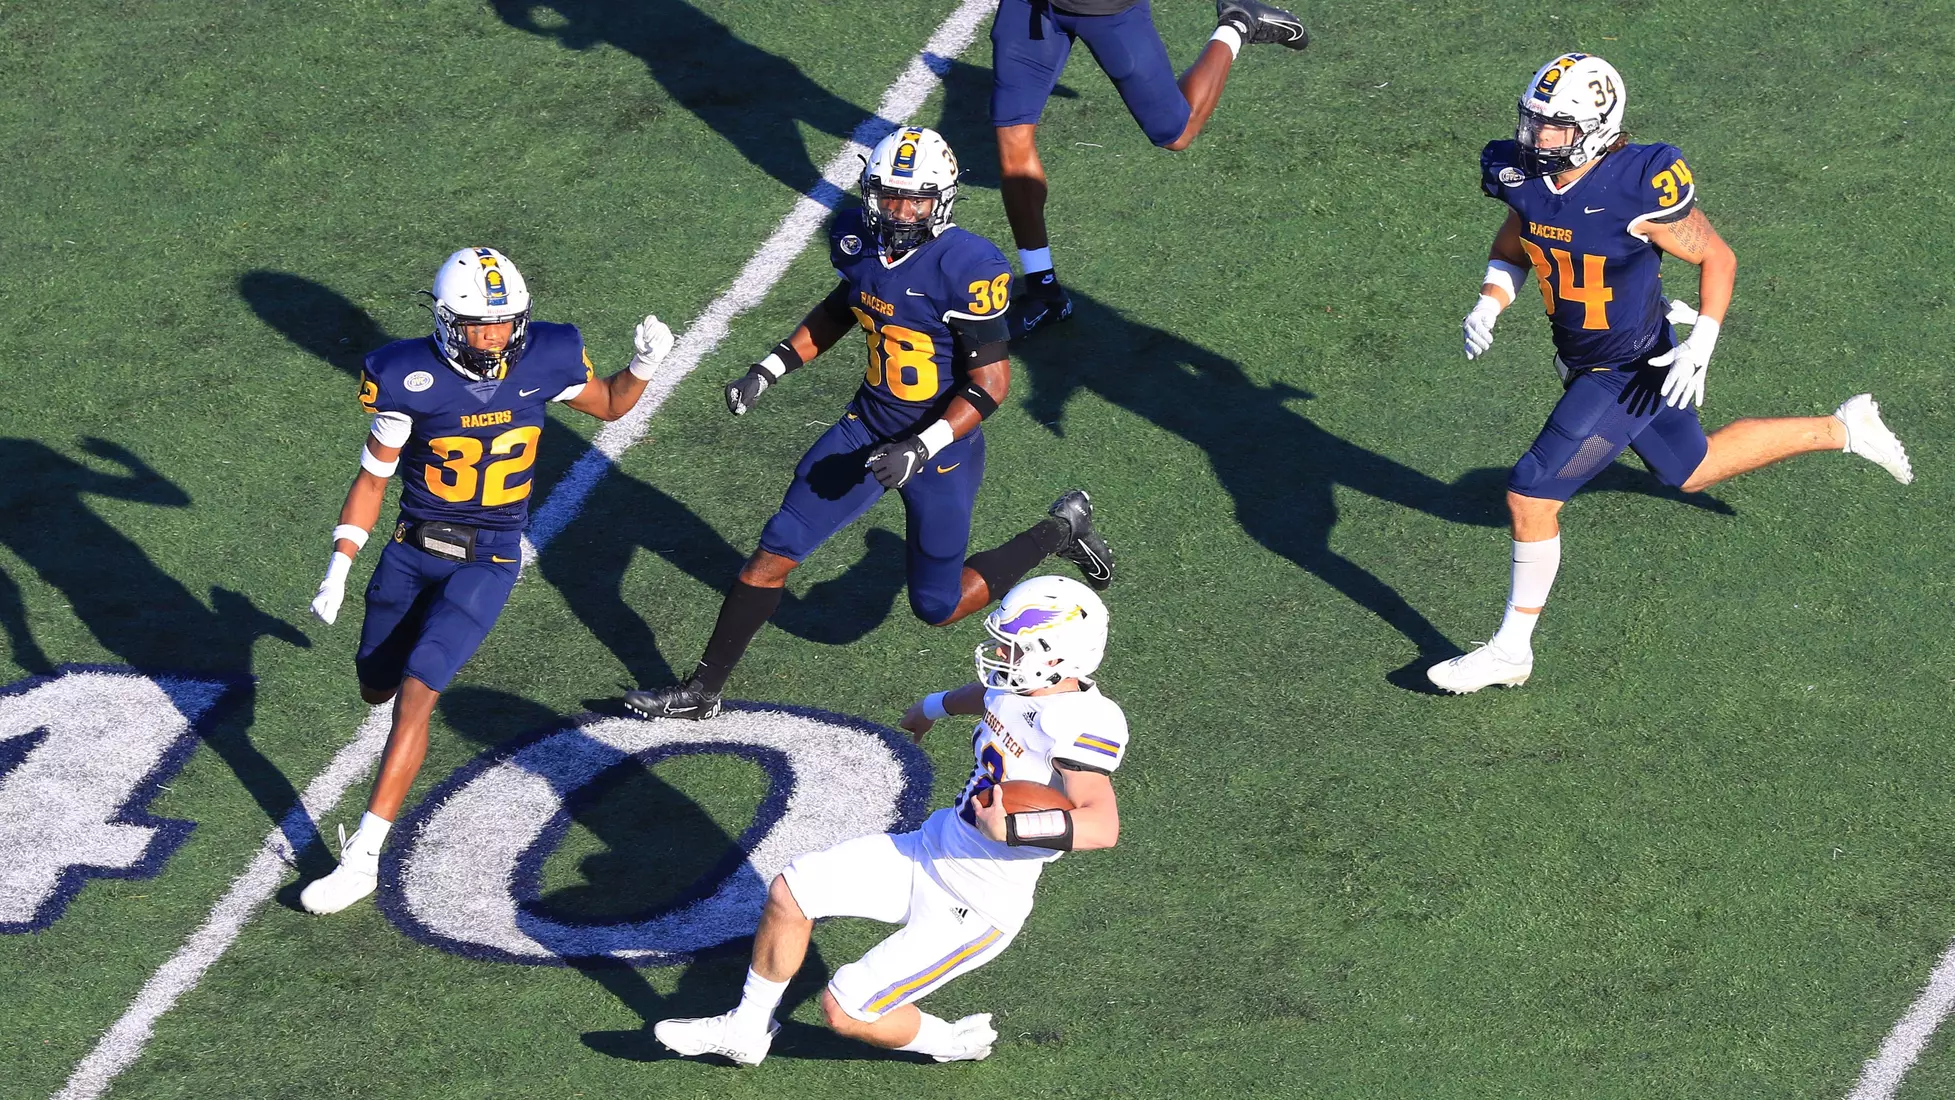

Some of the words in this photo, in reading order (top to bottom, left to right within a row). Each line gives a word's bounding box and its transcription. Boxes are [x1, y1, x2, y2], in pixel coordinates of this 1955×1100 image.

[1588, 75, 1618, 108] 34
[942, 147, 959, 175] 3
[1652, 159, 1694, 207] 34
[1529, 221, 1573, 243] RACERS
[968, 272, 1010, 314] 38
[1519, 236, 1613, 330] 34
[860, 291, 894, 317] RACERS
[850, 306, 939, 402] 38
[358, 370, 379, 413] 2
[460, 409, 512, 429] RACERS
[424, 425, 541, 507] 32
[1003, 732, 1025, 759] TECH
